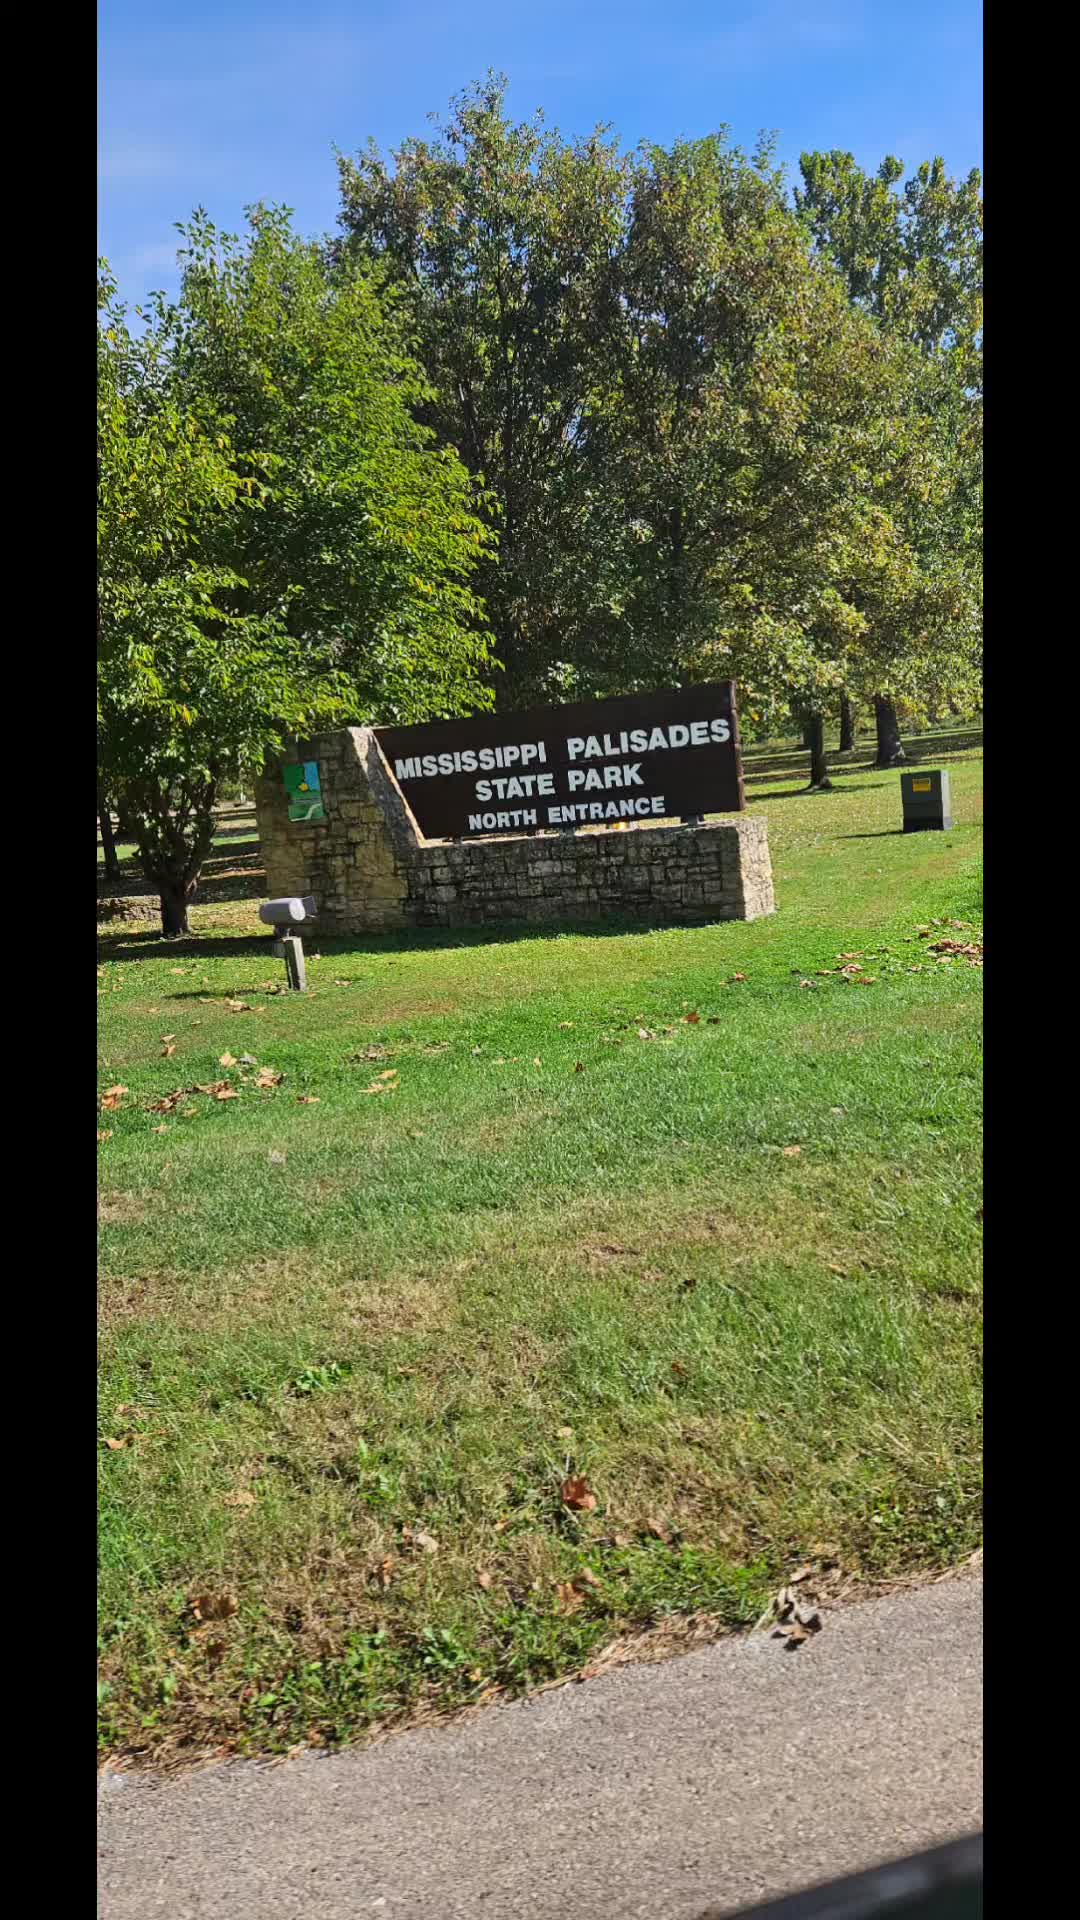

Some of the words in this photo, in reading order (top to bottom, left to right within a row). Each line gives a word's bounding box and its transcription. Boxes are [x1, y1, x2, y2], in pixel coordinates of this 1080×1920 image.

[395, 741, 547, 779] MISSISSIPPI
[567, 719, 730, 760] PALISADES
[476, 773, 555, 801] STATE
[568, 763, 644, 791] PARK
[469, 809, 536, 830] NORTH
[548, 796, 665, 823] ENTRANCE
